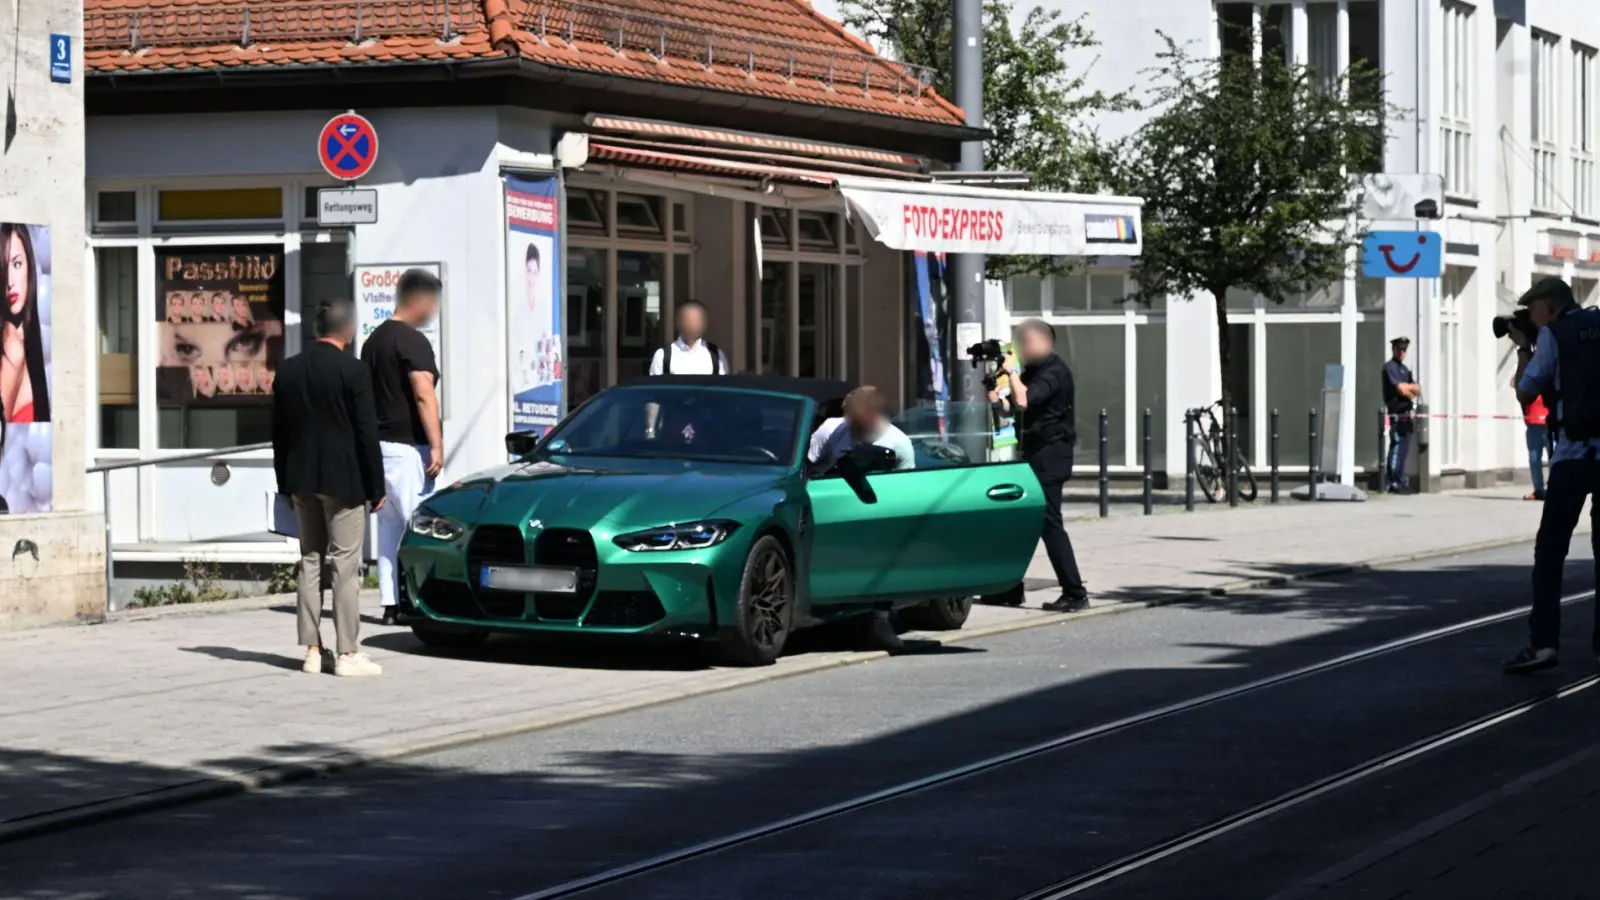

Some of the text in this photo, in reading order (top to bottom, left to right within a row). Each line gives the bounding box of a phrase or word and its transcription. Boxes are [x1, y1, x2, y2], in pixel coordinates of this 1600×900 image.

[57, 38, 66, 60] 3
[324, 202, 372, 214] Rettungsweg
[166, 255, 276, 280] Passbild
